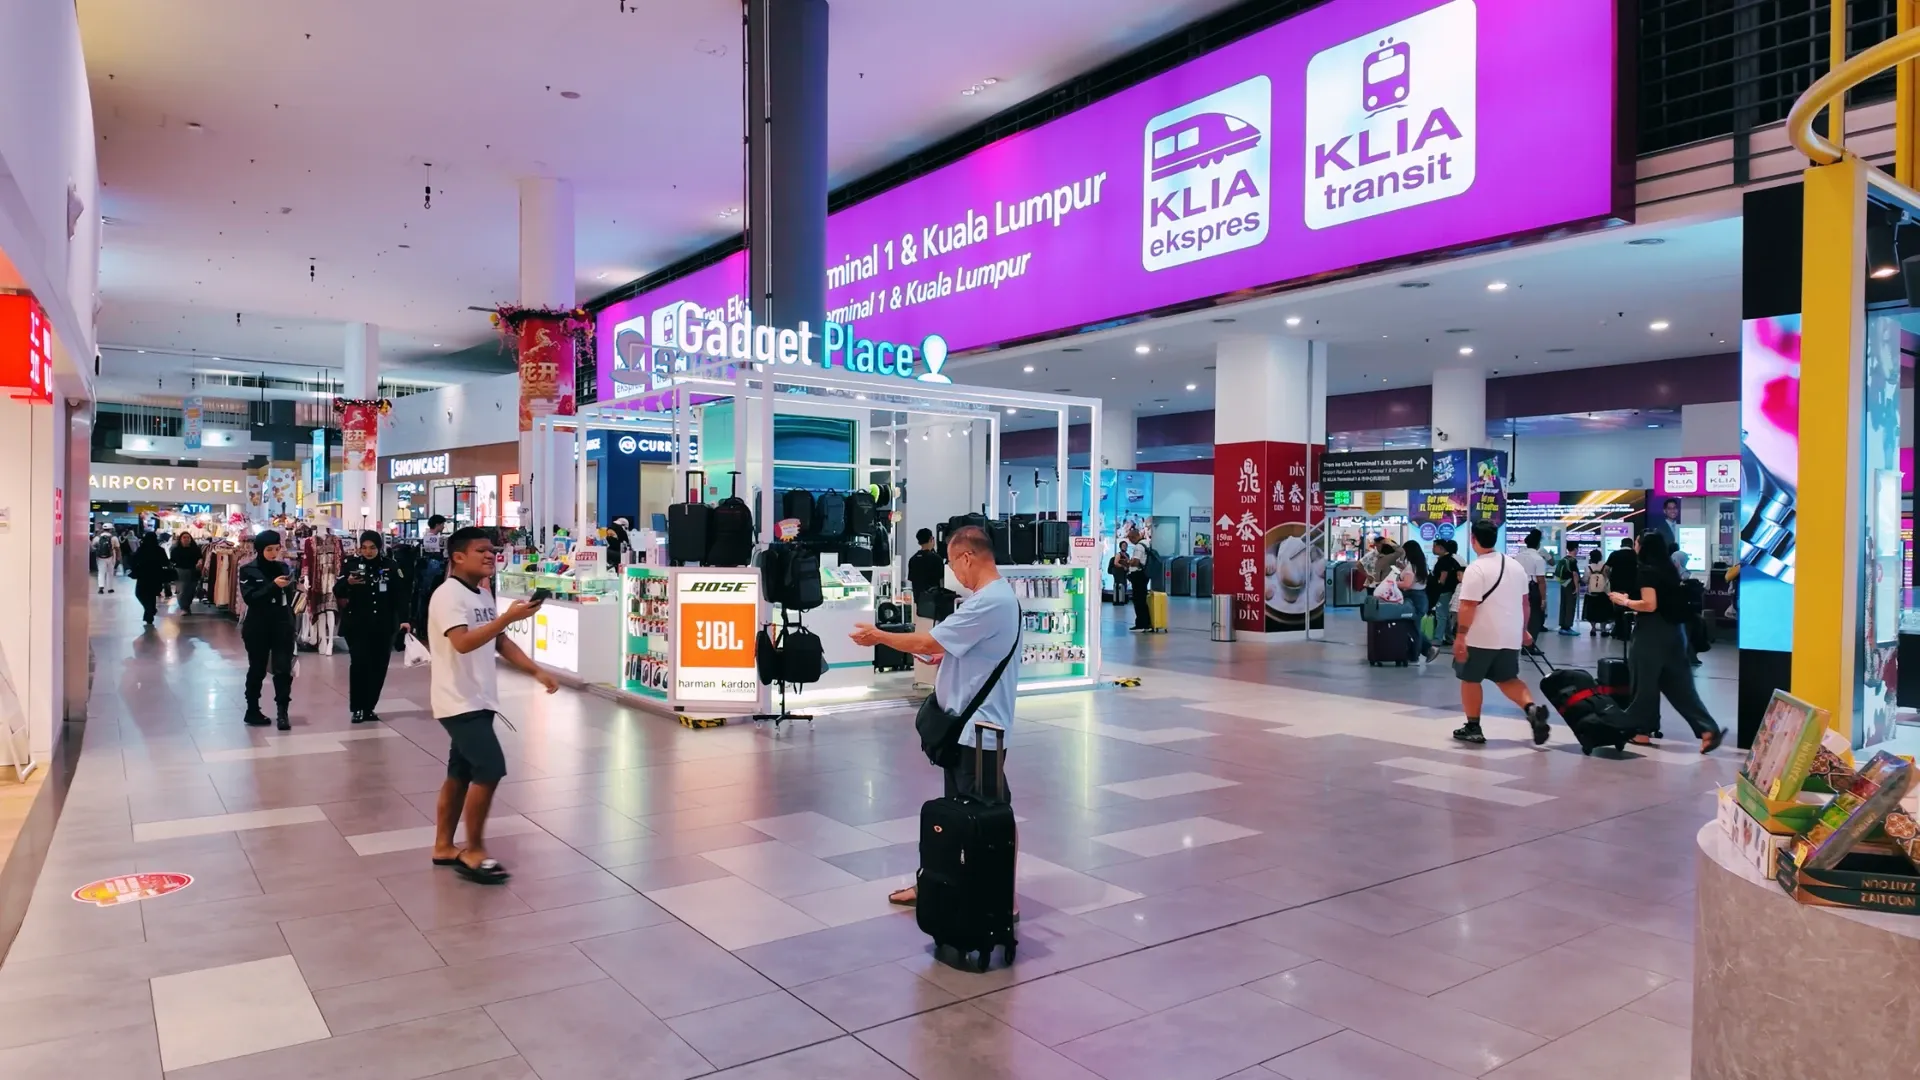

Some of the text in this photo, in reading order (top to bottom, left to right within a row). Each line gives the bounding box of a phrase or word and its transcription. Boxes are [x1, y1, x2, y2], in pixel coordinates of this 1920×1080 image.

[1313, 107, 1464, 179] KLIA
[1323, 151, 1453, 210] transit
[1149, 168, 1261, 228] KLIA
[827, 171, 1107, 290] minal 1 & Kuala Lumpur
[1149, 211, 1261, 258] ekspres
[826, 252, 1032, 324] erminal 1 & Kuala Lumpur
[677, 301, 812, 373] Gadget
[823, 322, 914, 378] Place
[89, 474, 243, 494] AIRPORT HOTEL
[181, 504, 211, 514] ATM
[1241, 495, 1257, 504] DIN
[1236, 509, 1264, 541] 泰
[1242, 544, 1256, 553] TAI
[681, 582, 757, 592] BOSE
[1237, 592, 1260, 602] FUNG
[696, 621, 744, 650] JBL
[678, 679, 756, 688] harman kardon
[1861, 879, 1916, 892] ZAITOUN
[1860, 892, 1916, 907] ZAITOUN
